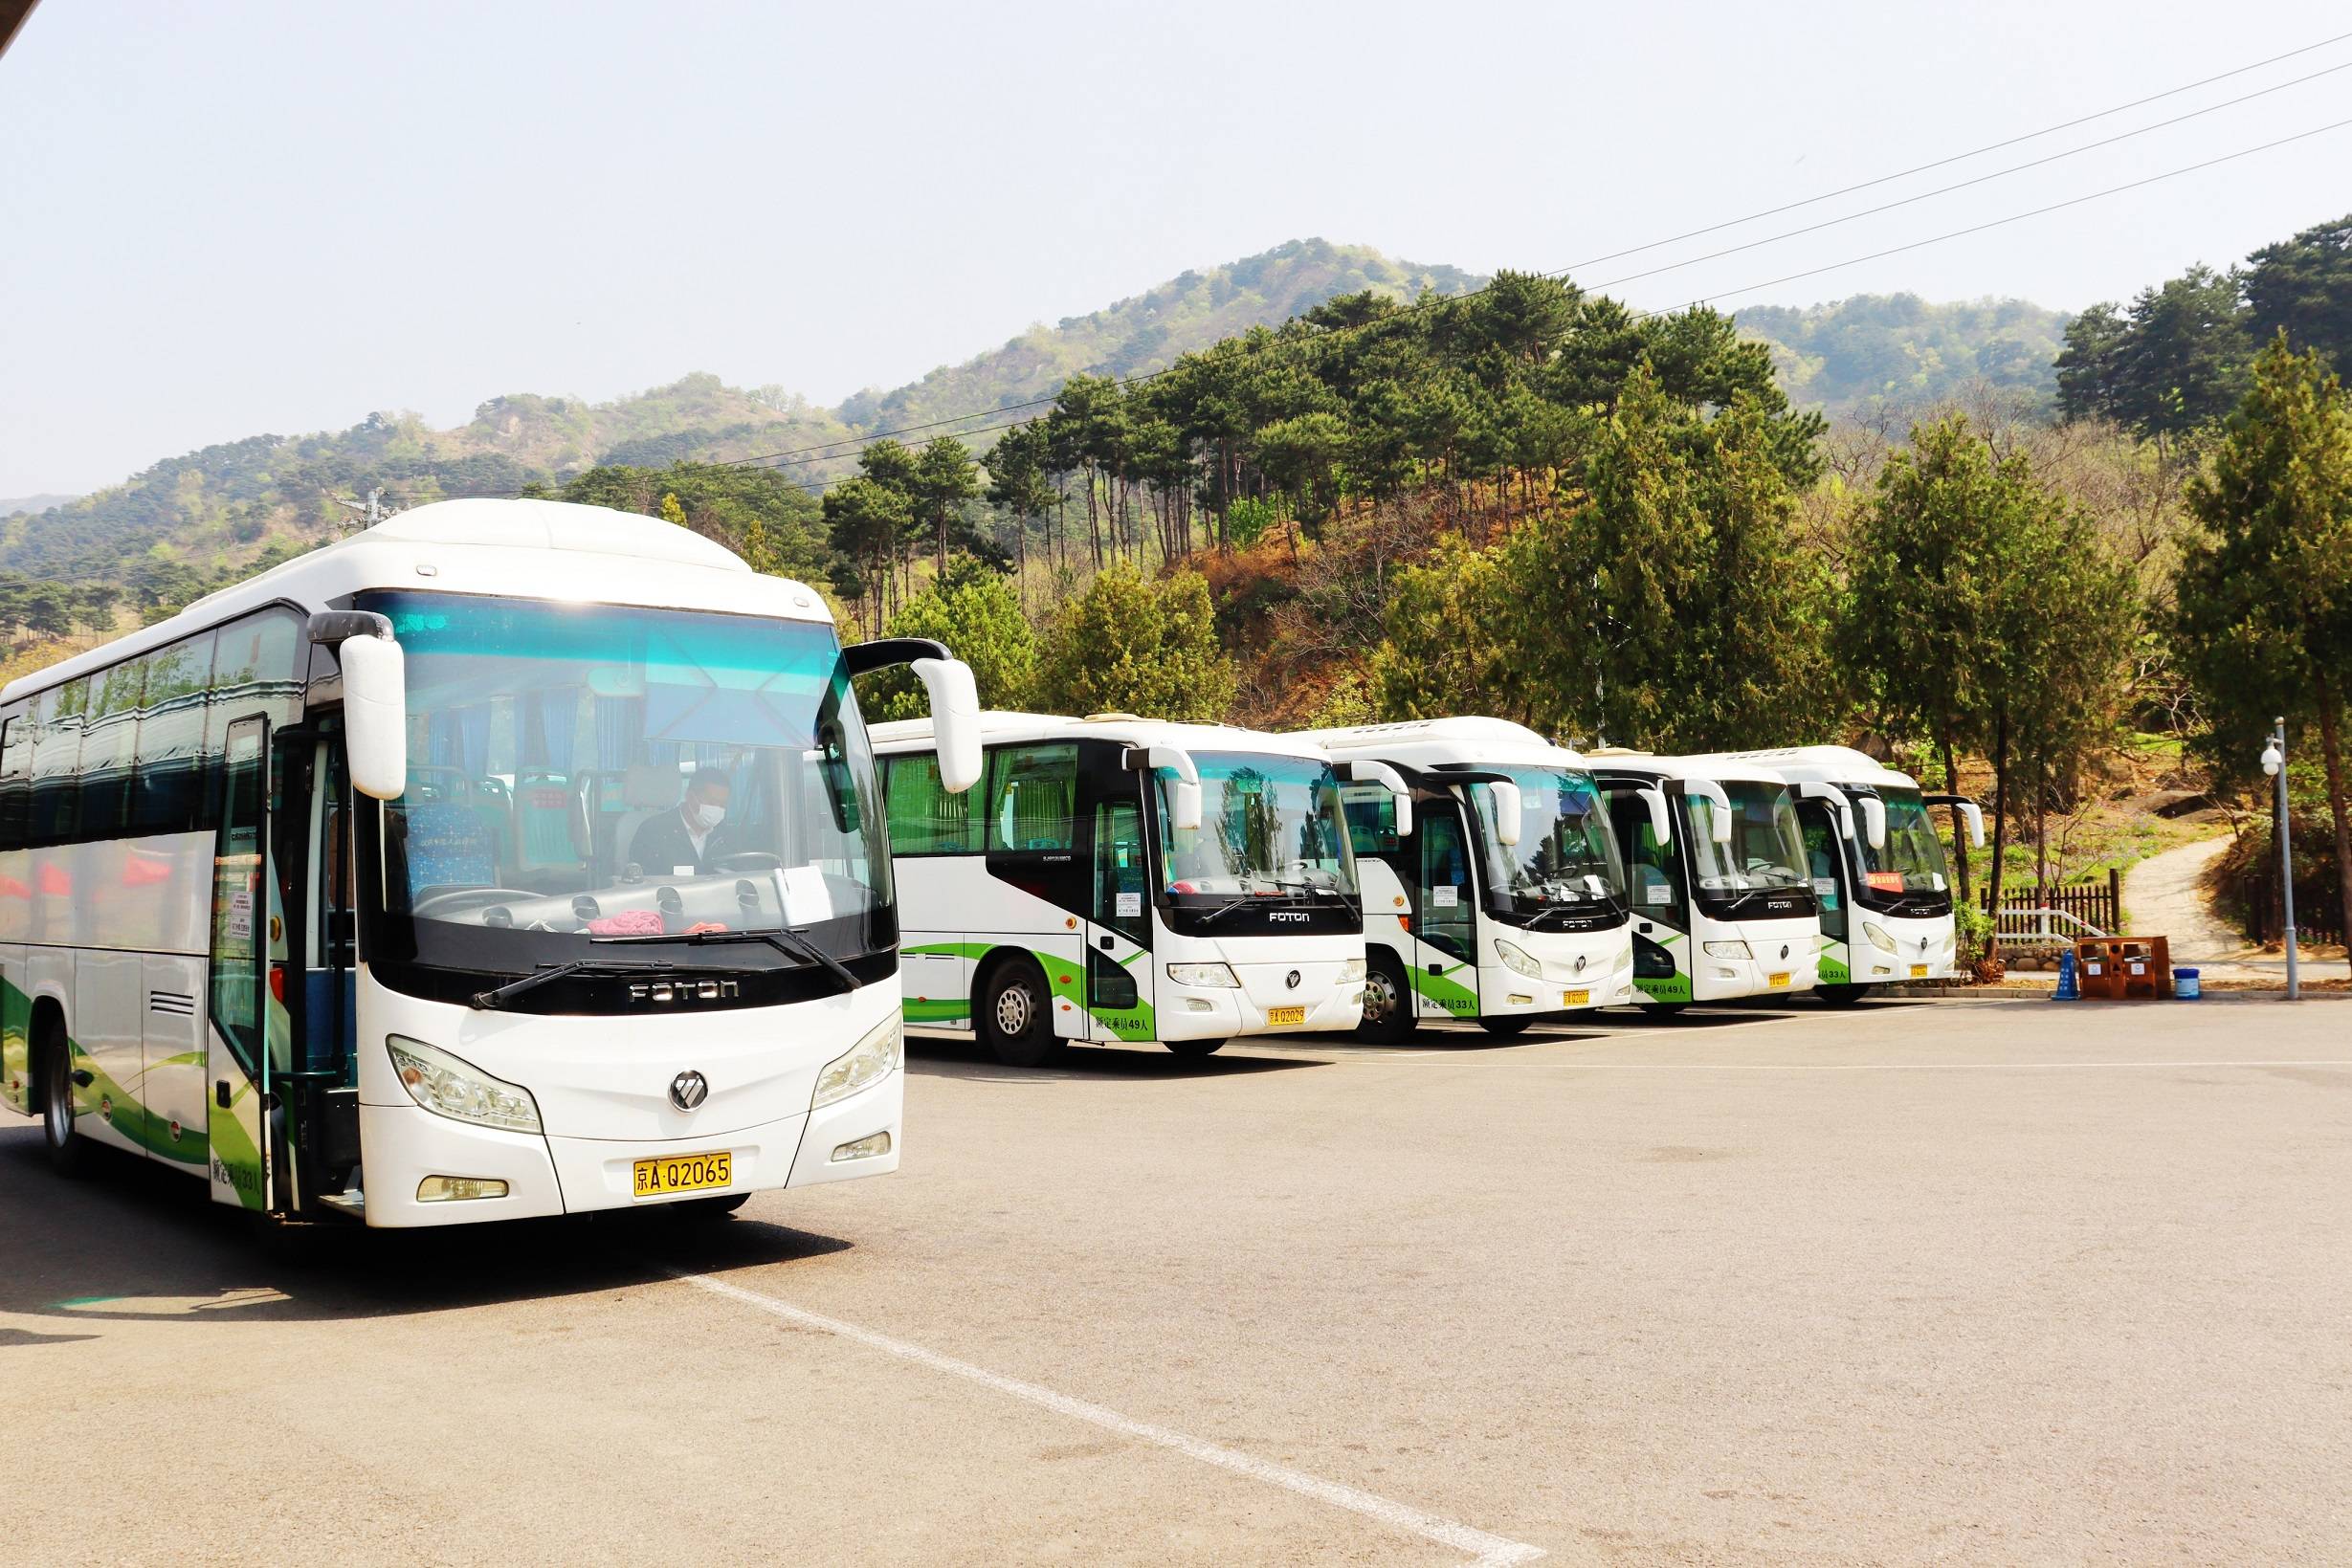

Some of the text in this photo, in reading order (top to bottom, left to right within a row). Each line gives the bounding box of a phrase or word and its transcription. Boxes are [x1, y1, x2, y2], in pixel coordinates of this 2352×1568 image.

[1767, 901, 1792, 910] FOTON
[1269, 912, 1310, 922] FOTON
[1563, 919, 1593, 929] FOTON
[629, 980, 740, 1003] FOTON
